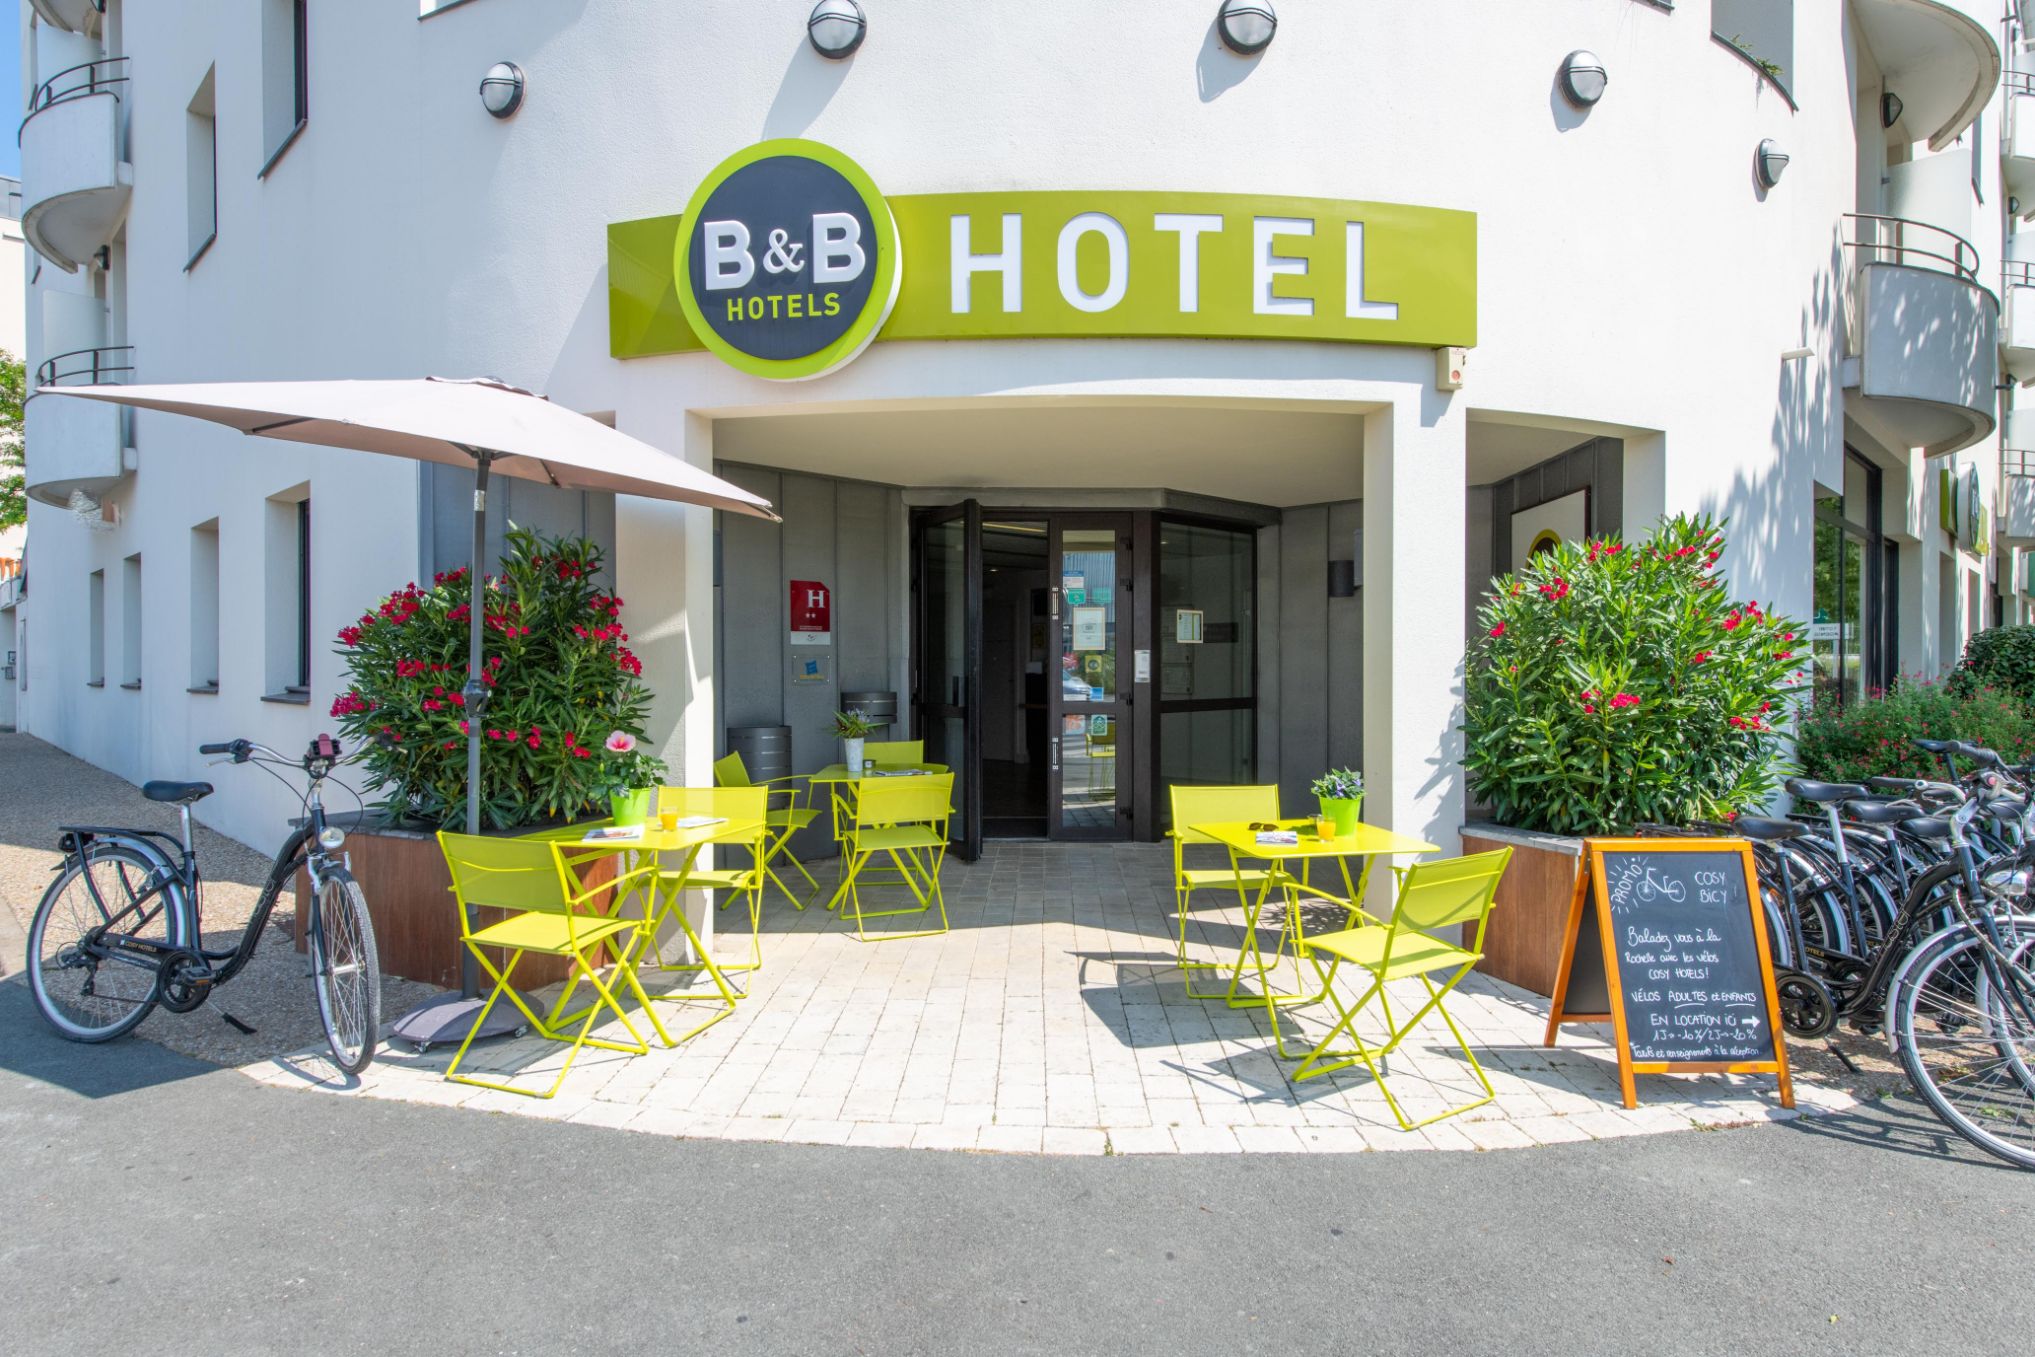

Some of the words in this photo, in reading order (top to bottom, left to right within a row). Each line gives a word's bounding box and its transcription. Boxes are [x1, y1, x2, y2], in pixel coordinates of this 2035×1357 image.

[704, 212, 866, 291] B&B
[949, 212, 1399, 321] HOTEL
[727, 292, 841, 321] HOTELS
[806, 589, 826, 608] H
[1610, 863, 1643, 904] PROMO
[1694, 871, 1726, 886] COSY
[1627, 925, 1672, 953] Baladez
[1674, 933, 1694, 943] vous
[1695, 928, 1704, 942] à
[1706, 928, 1721, 942] la
[1624, 951, 1656, 963] Rochelle
[1659, 954, 1679, 963] avec
[1682, 951, 1694, 963] les
[1696, 950, 1719, 963] vélos
[1648, 968, 1670, 981] COSY
[1631, 988, 1661, 1003] VÉLOS
[1668, 990, 1708, 1002] ADULTES
[1721, 992, 1757, 1002] ENFANTS
[1650, 1013, 1669, 1026] EN
